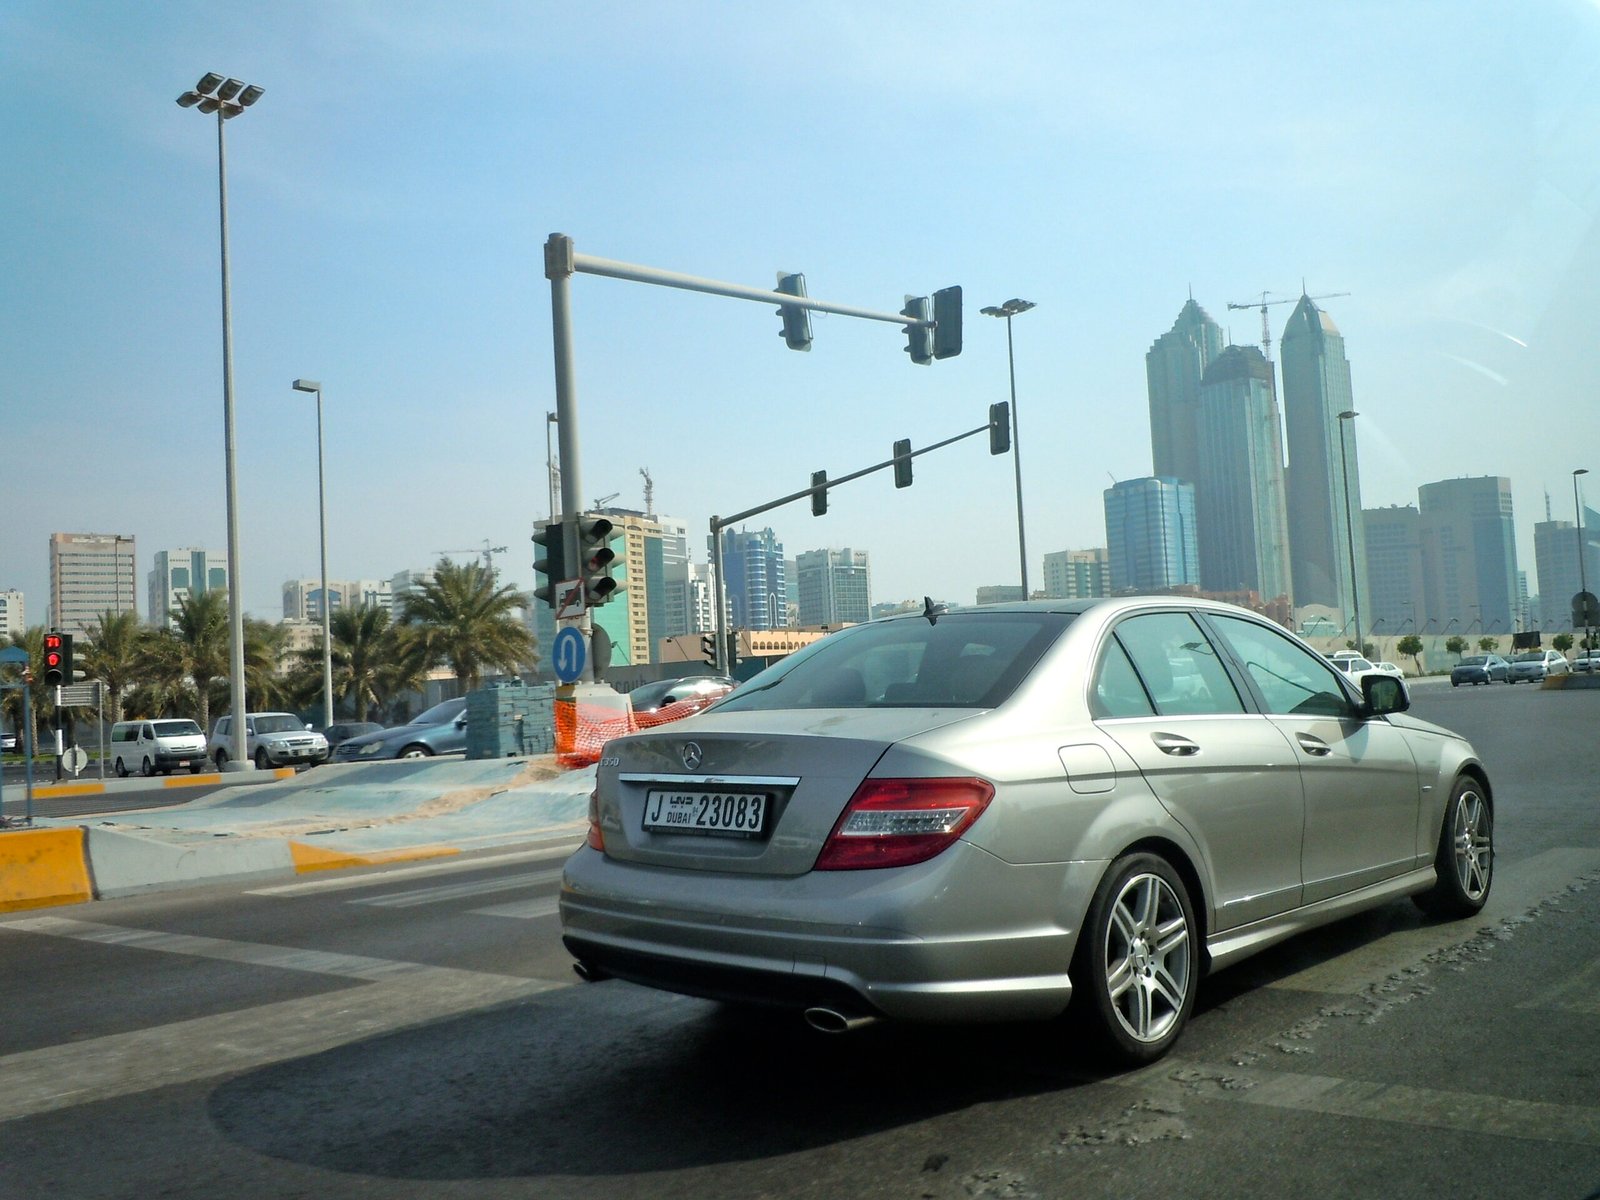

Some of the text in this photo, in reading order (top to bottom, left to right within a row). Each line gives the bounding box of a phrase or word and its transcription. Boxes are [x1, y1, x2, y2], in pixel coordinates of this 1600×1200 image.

[670, 796, 693, 808] دبي
[651, 794, 763, 829] J 23083
[666, 811, 691, 826] DUBAI
